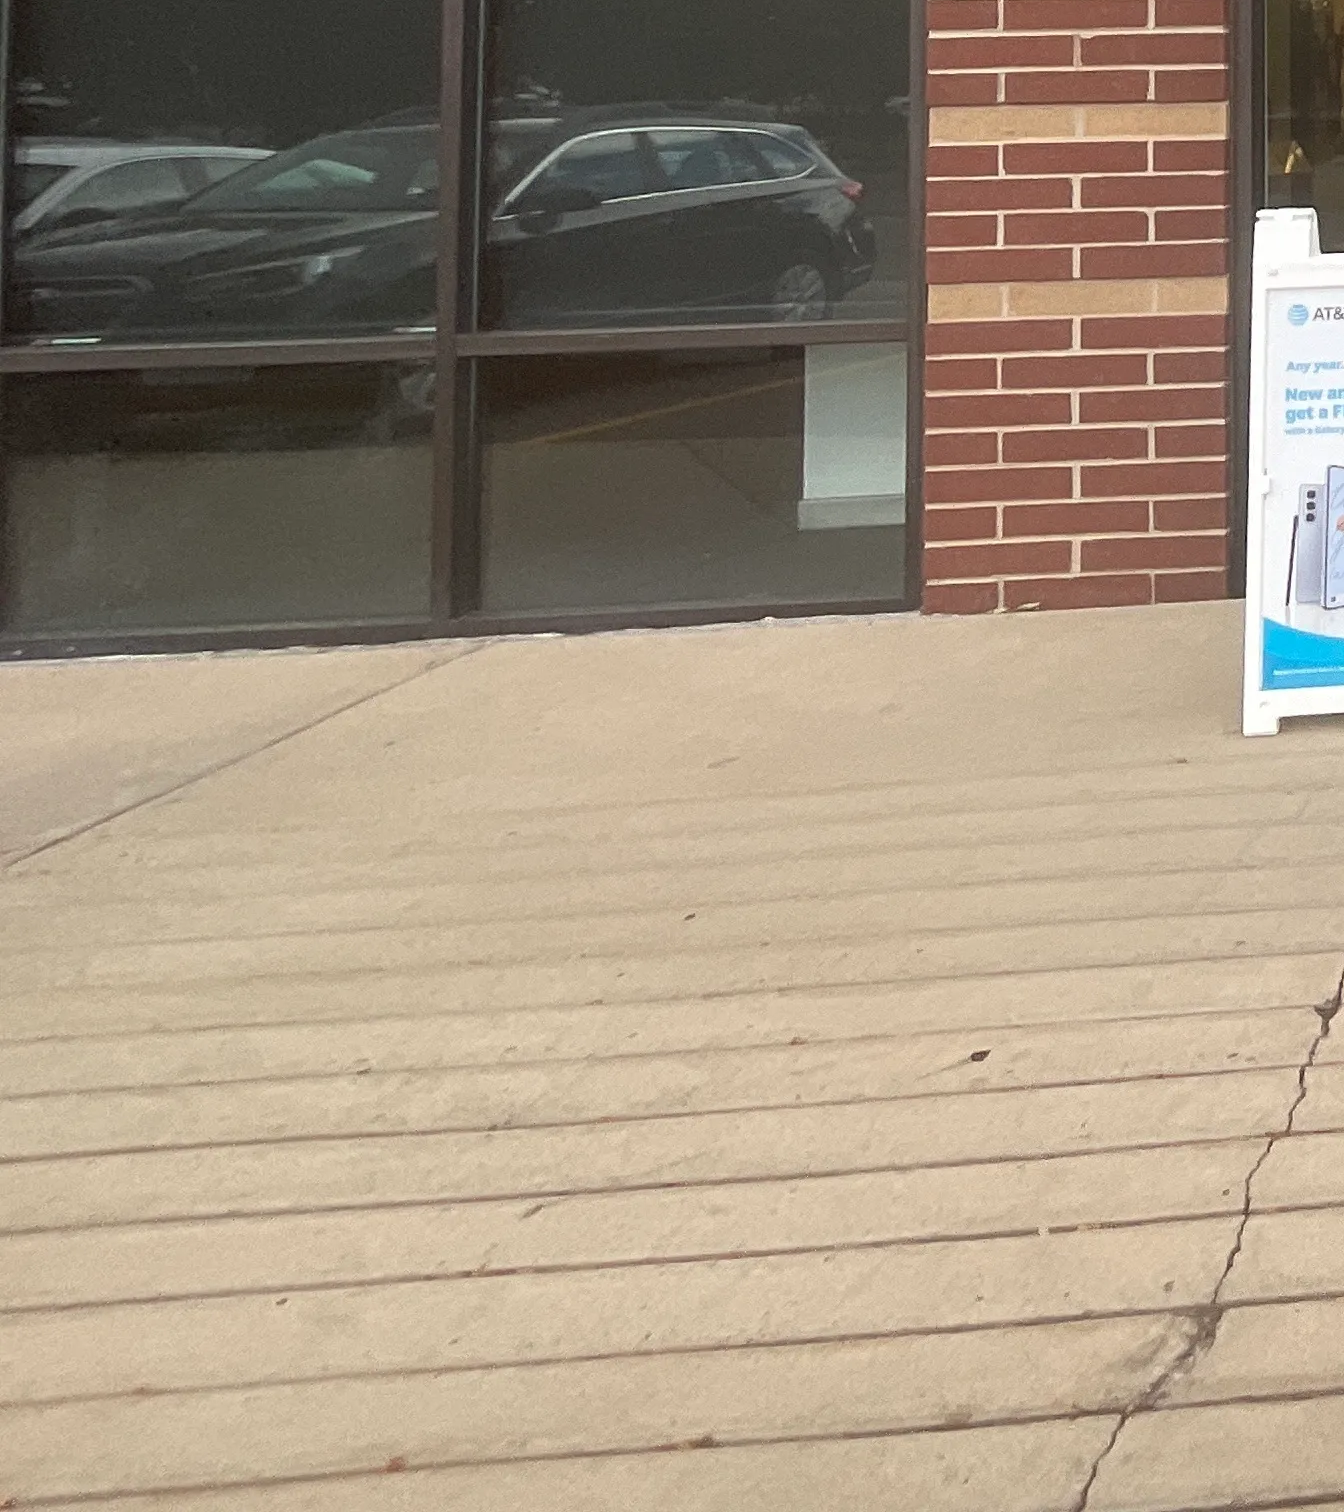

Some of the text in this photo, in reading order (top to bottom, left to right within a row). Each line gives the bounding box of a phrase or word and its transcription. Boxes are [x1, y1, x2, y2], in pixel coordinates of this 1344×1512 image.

[1286, 360, 1311, 373] Any
[1314, 360, 1344, 374] year.
[1285, 387, 1324, 402] New
[1285, 405, 1315, 424] get
[1318, 407, 1328, 420] a
